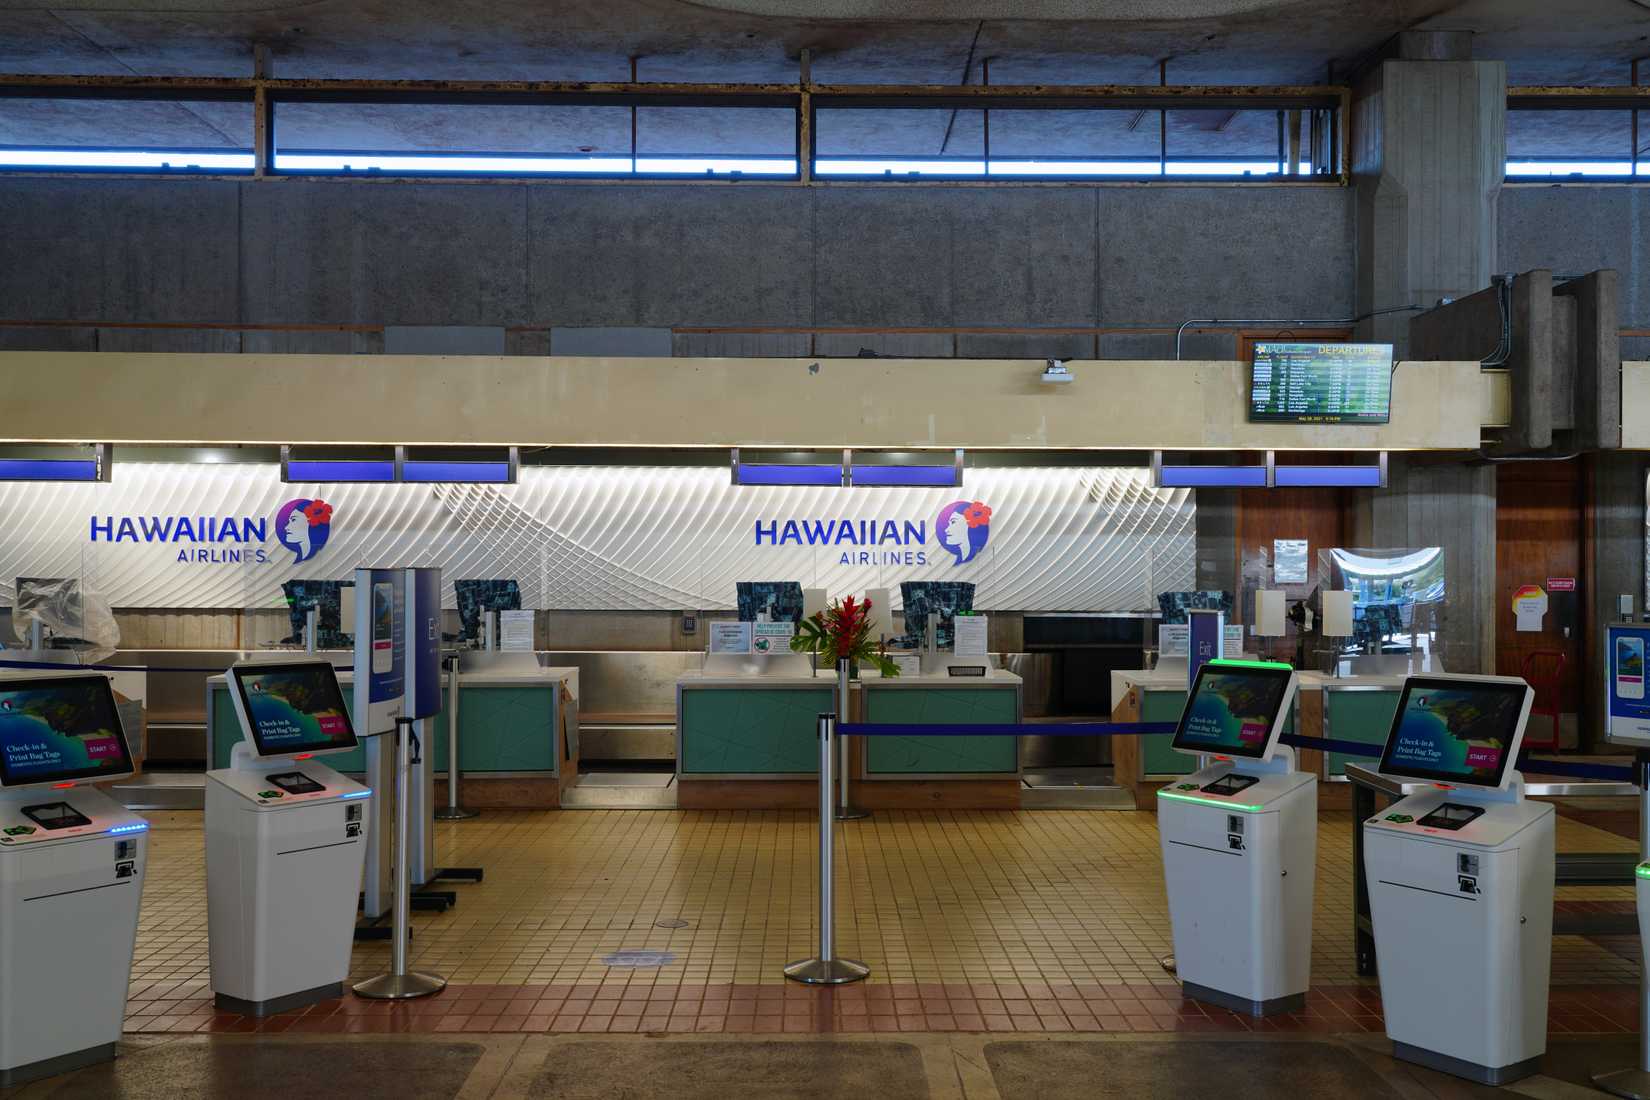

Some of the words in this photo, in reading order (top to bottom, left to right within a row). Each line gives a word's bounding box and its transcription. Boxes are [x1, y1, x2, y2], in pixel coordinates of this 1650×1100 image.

[90, 516, 266, 543] HAWAIIAN
[755, 520, 926, 545] HAWAIIAN
[177, 549, 266, 563] AIRLINES
[839, 551, 926, 566] AIRLINES
